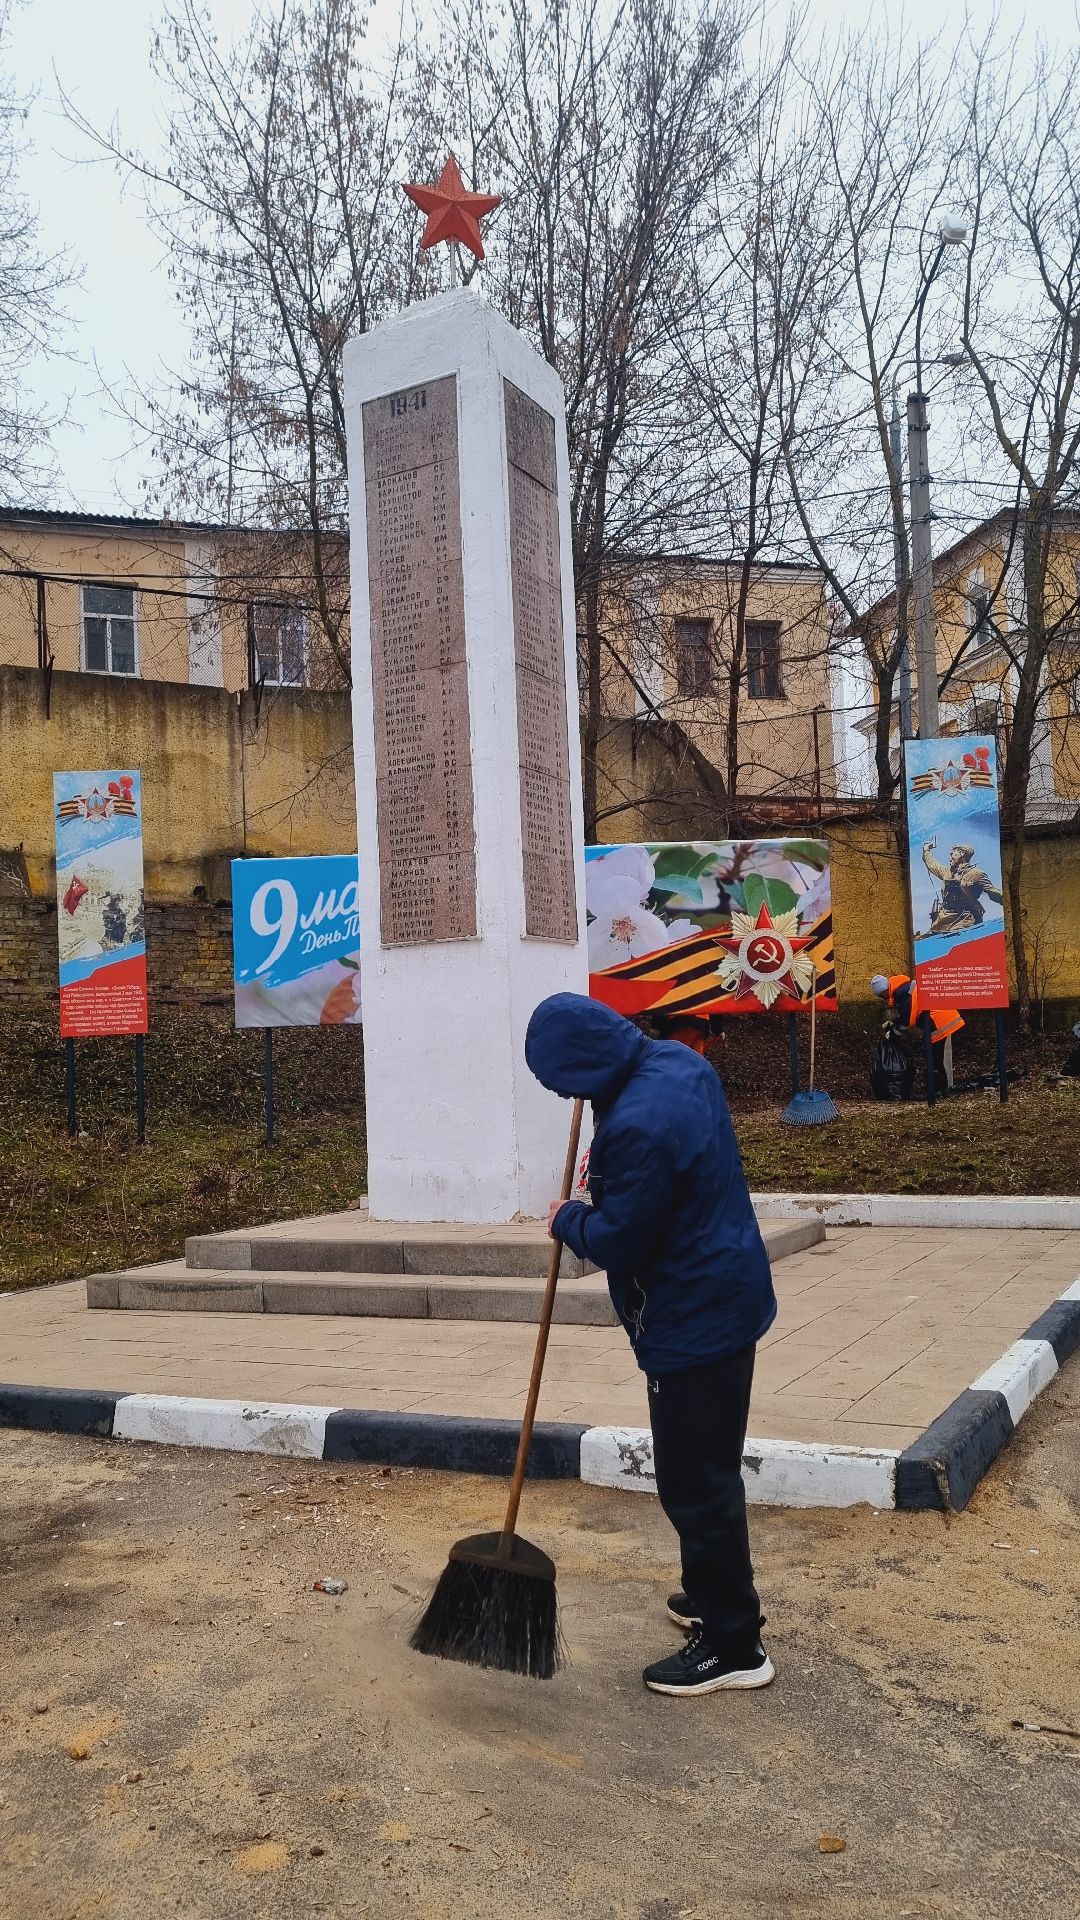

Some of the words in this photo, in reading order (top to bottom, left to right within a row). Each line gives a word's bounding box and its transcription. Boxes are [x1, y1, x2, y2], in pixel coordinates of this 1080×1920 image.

[390, 390, 427, 418] 1941
[384, 704, 416, 717] ИВАНОВ
[250, 879, 298, 974] 9
[300, 881, 359, 930] ма
[300, 929, 341, 955] День
